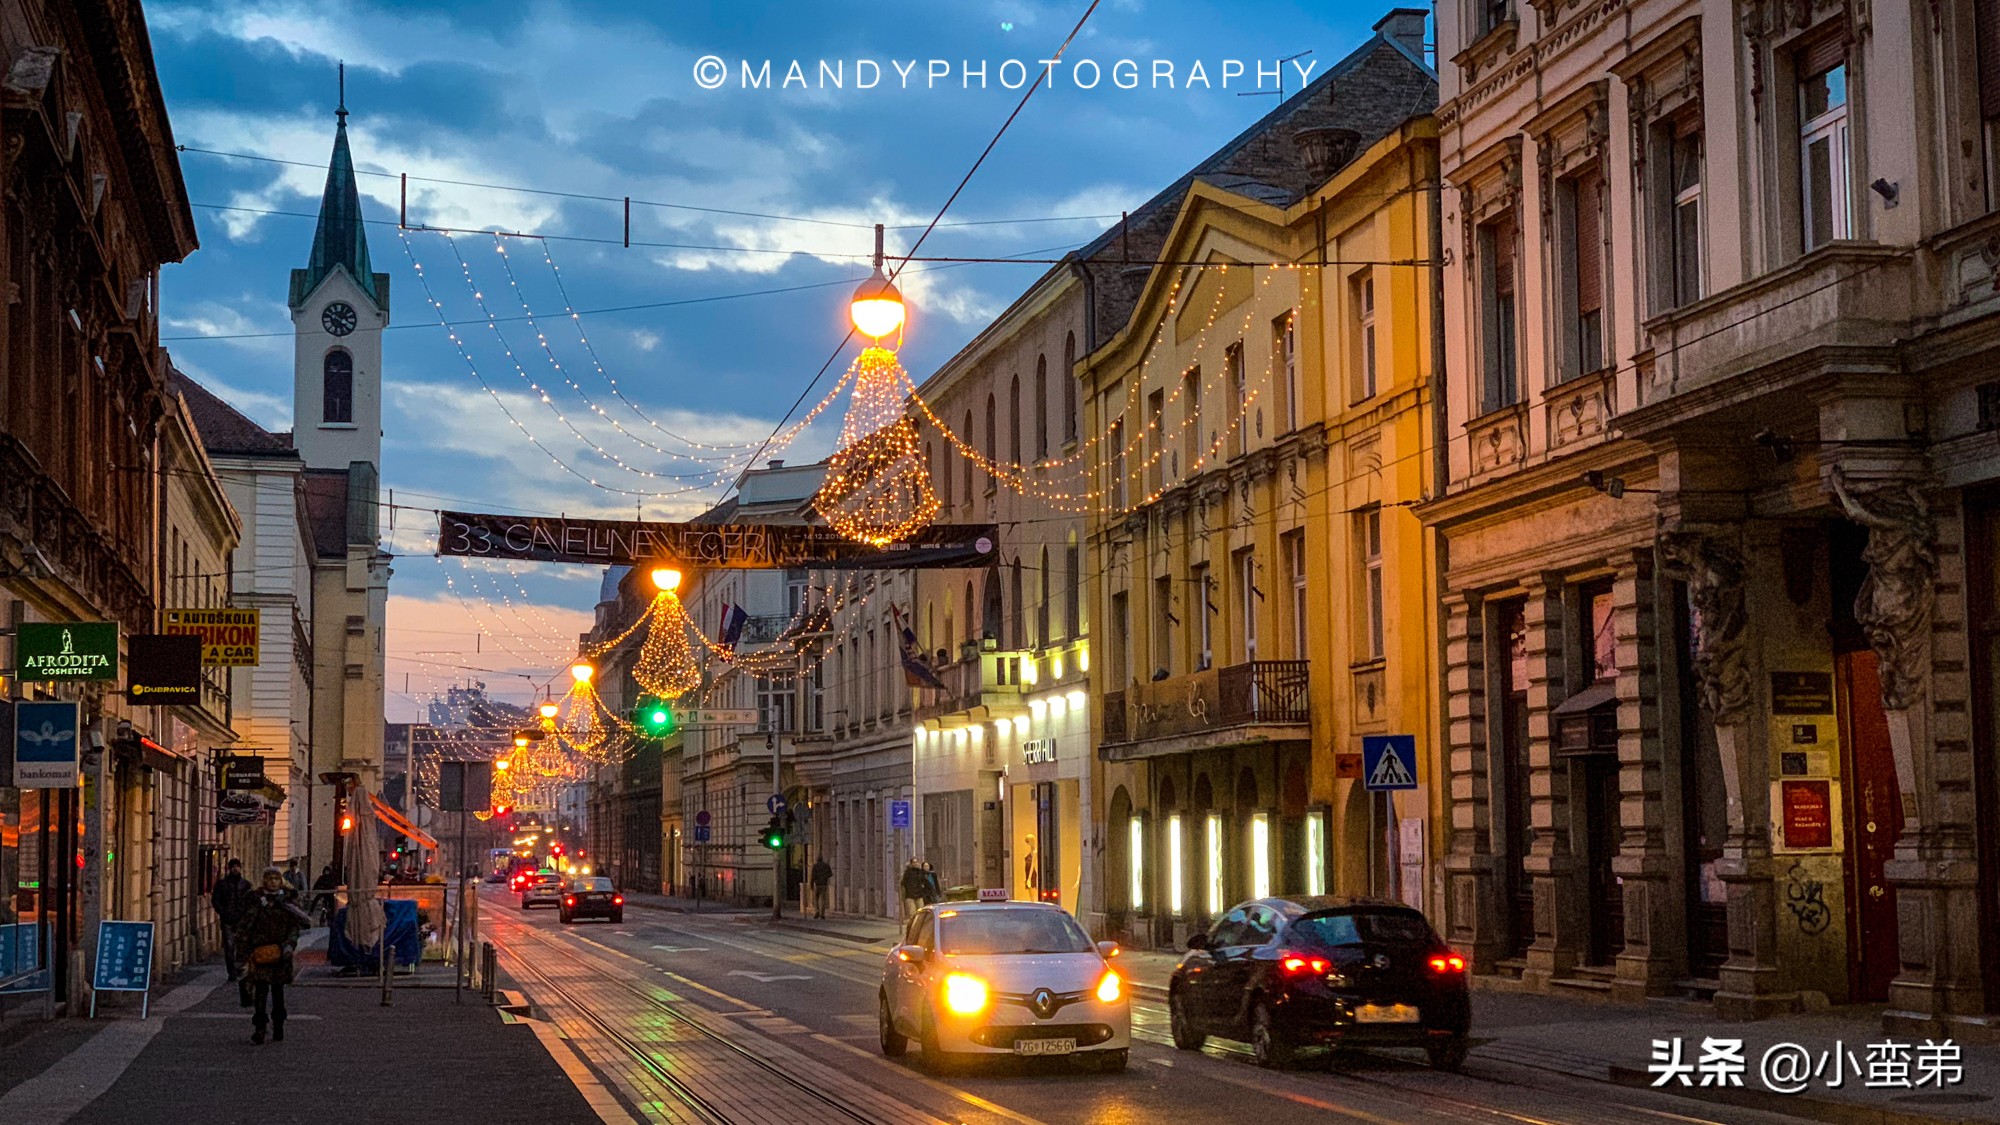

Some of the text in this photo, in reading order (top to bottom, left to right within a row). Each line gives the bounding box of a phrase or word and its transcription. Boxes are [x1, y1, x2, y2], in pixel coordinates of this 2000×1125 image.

[450, 523, 498, 554] 33.
[183, 611, 256, 625] AUTOŠKOLA
[210, 647, 254, 657] A CAR
[25, 655, 110, 668] AFRODITA
[20, 769, 72, 779] bankomat
